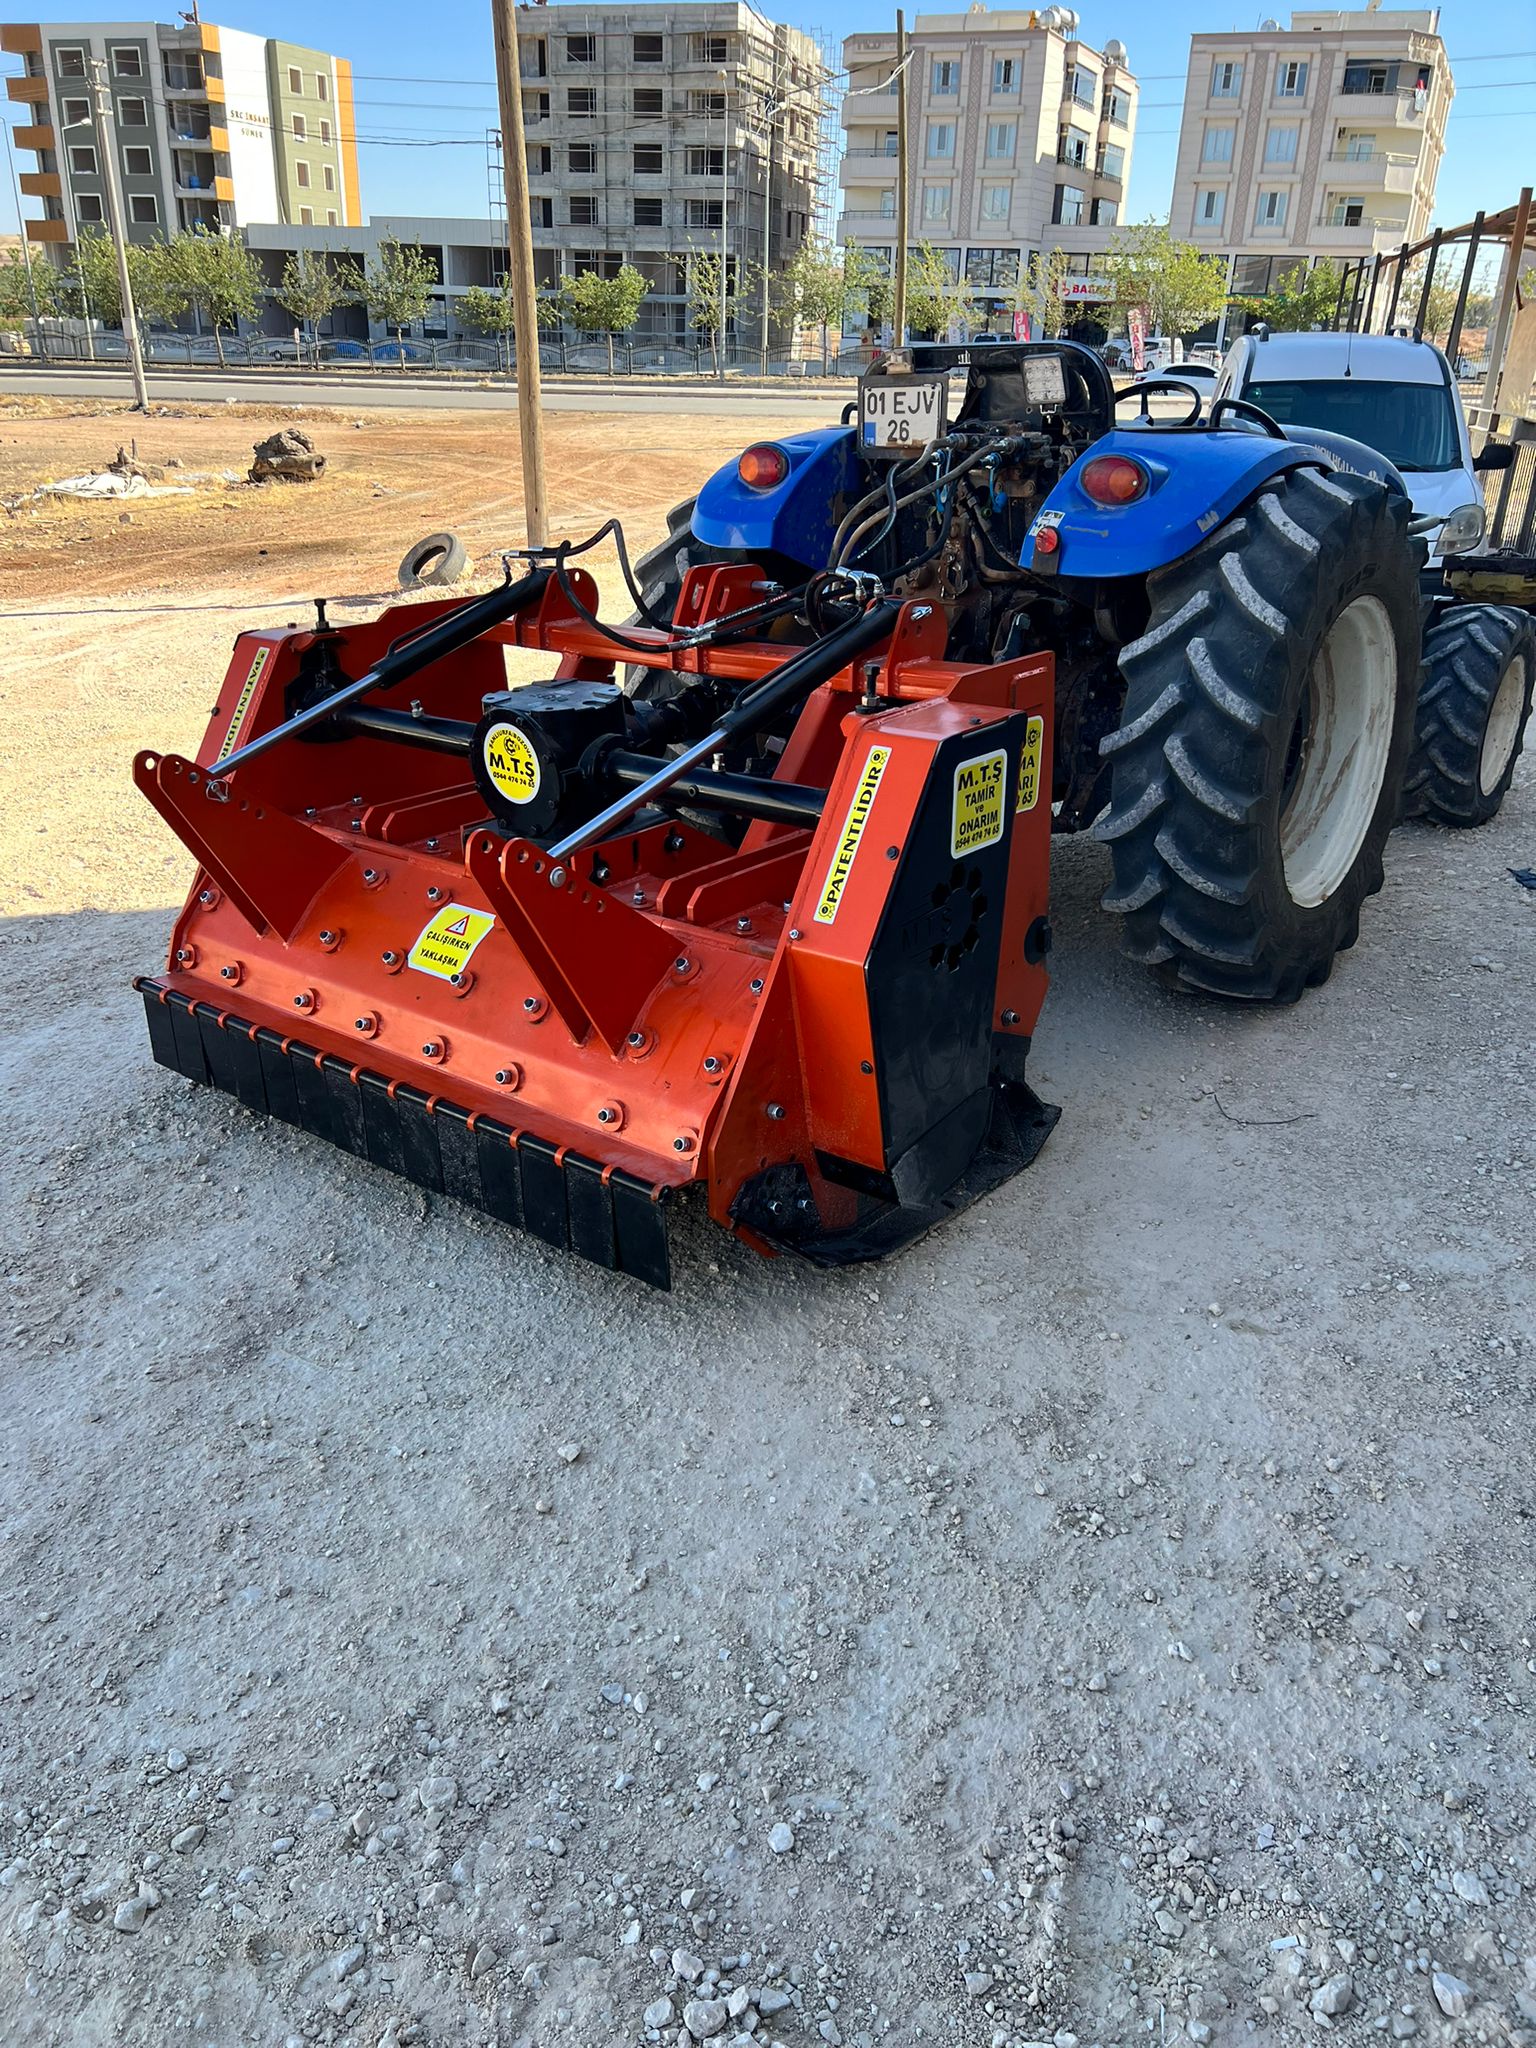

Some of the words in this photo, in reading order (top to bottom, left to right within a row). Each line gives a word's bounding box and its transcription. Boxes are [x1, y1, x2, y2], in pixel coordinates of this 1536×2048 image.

[867, 391, 885, 415] 01
[893, 390, 935, 414] EJV
[887, 419, 910, 442] 26
[965, 784, 995, 807] TAMİR
[974, 804, 984, 814] ve
[959, 809, 998, 836] ONARIM
[826, 766, 882, 903] PATENTLİDİR
[955, 836, 970, 850] 0544
[971, 831, 983, 843] 474
[983, 827, 991, 838] 74
[426, 930, 471, 951] ÇALIŞIRKEN
[420, 947, 459, 967] YAKLAŞMA
